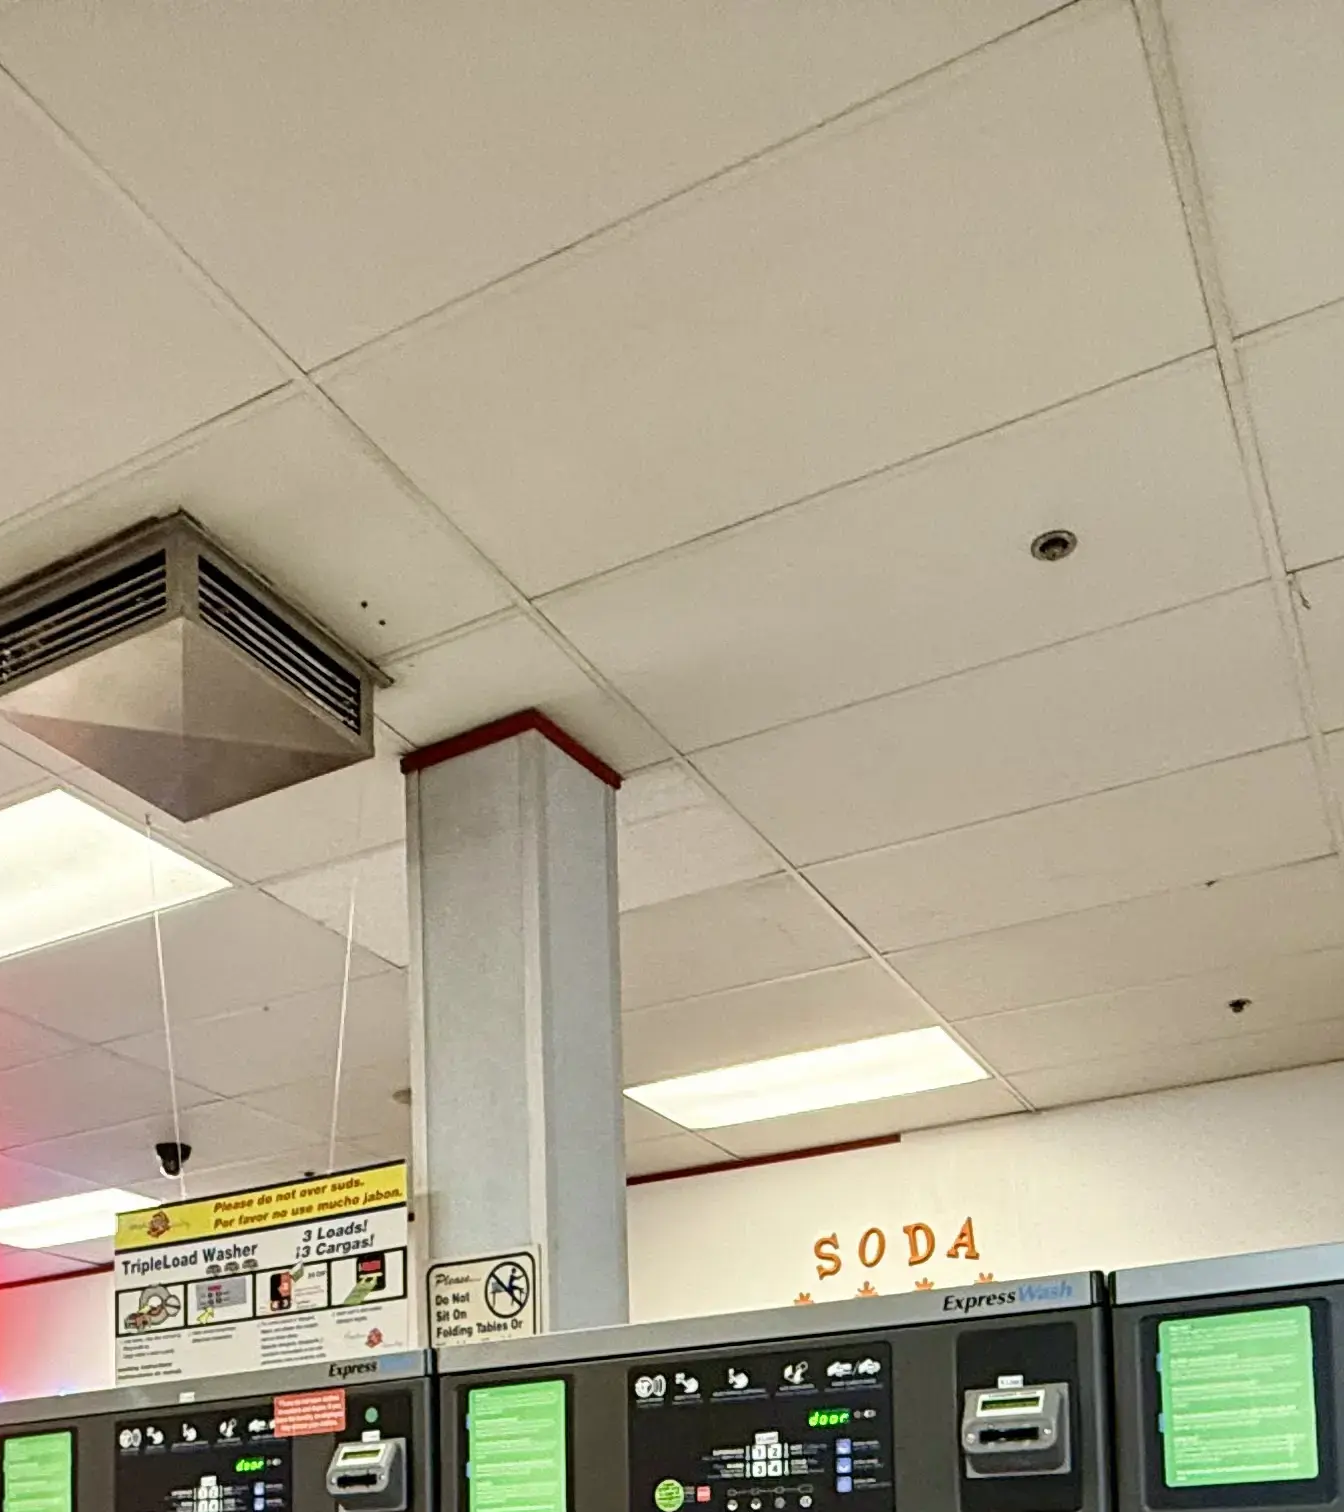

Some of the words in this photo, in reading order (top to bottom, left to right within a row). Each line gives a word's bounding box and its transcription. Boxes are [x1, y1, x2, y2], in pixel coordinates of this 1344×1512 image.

[213, 1197, 255, 1213] Please
[257, 1194, 273, 1206] do
[276, 1189, 296, 1201] not
[299, 1184, 328, 1197] over
[330, 1177, 365, 1190] suds.
[214, 1218, 235, 1230] Por
[238, 1211, 269, 1225] favor
[272, 1208, 288, 1218] no
[291, 1204, 313, 1214] use
[317, 1196, 360, 1210] mucho
[362, 1189, 403, 1205] jabon.
[302, 1229, 313, 1243] 3
[317, 1219, 369, 1240] Loads!
[315, 1234, 375, 1256] Cargas!
[814, 1216, 980, 1280] SODA
[122, 1250, 198, 1276] TripleLoad
[202, 1244, 258, 1263] Washer
[435, 1294, 449, 1306] Do
[452, 1292, 470, 1304] Not
[436, 1310, 449, 1322] Sit
[452, 1308, 467, 1320] On
[436, 1325, 473, 1338] Folding
[476, 1320, 508, 1334] Tables
[510, 1318, 524, 1330] Or
